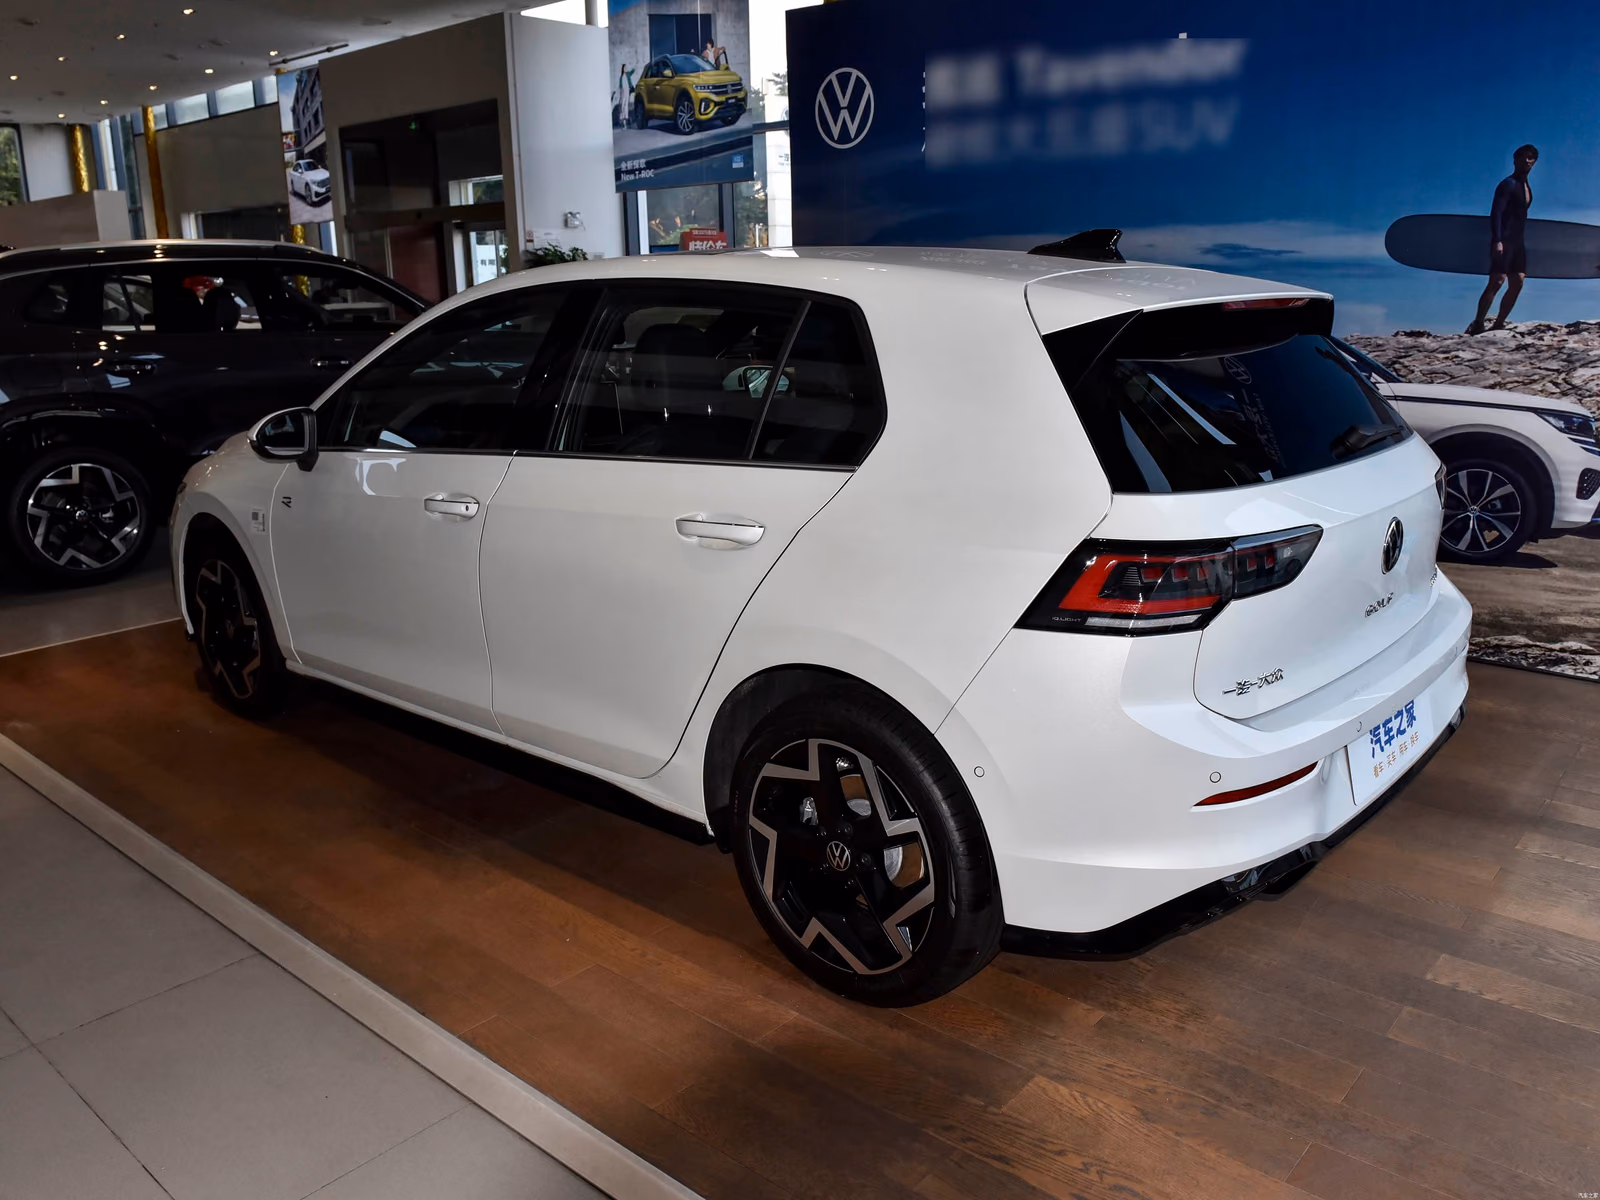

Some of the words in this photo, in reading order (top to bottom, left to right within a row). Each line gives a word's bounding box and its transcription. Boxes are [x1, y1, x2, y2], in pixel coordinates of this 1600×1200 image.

[620, 172, 635, 181] New
[1369, 699, 1416, 759] 汽车之家
